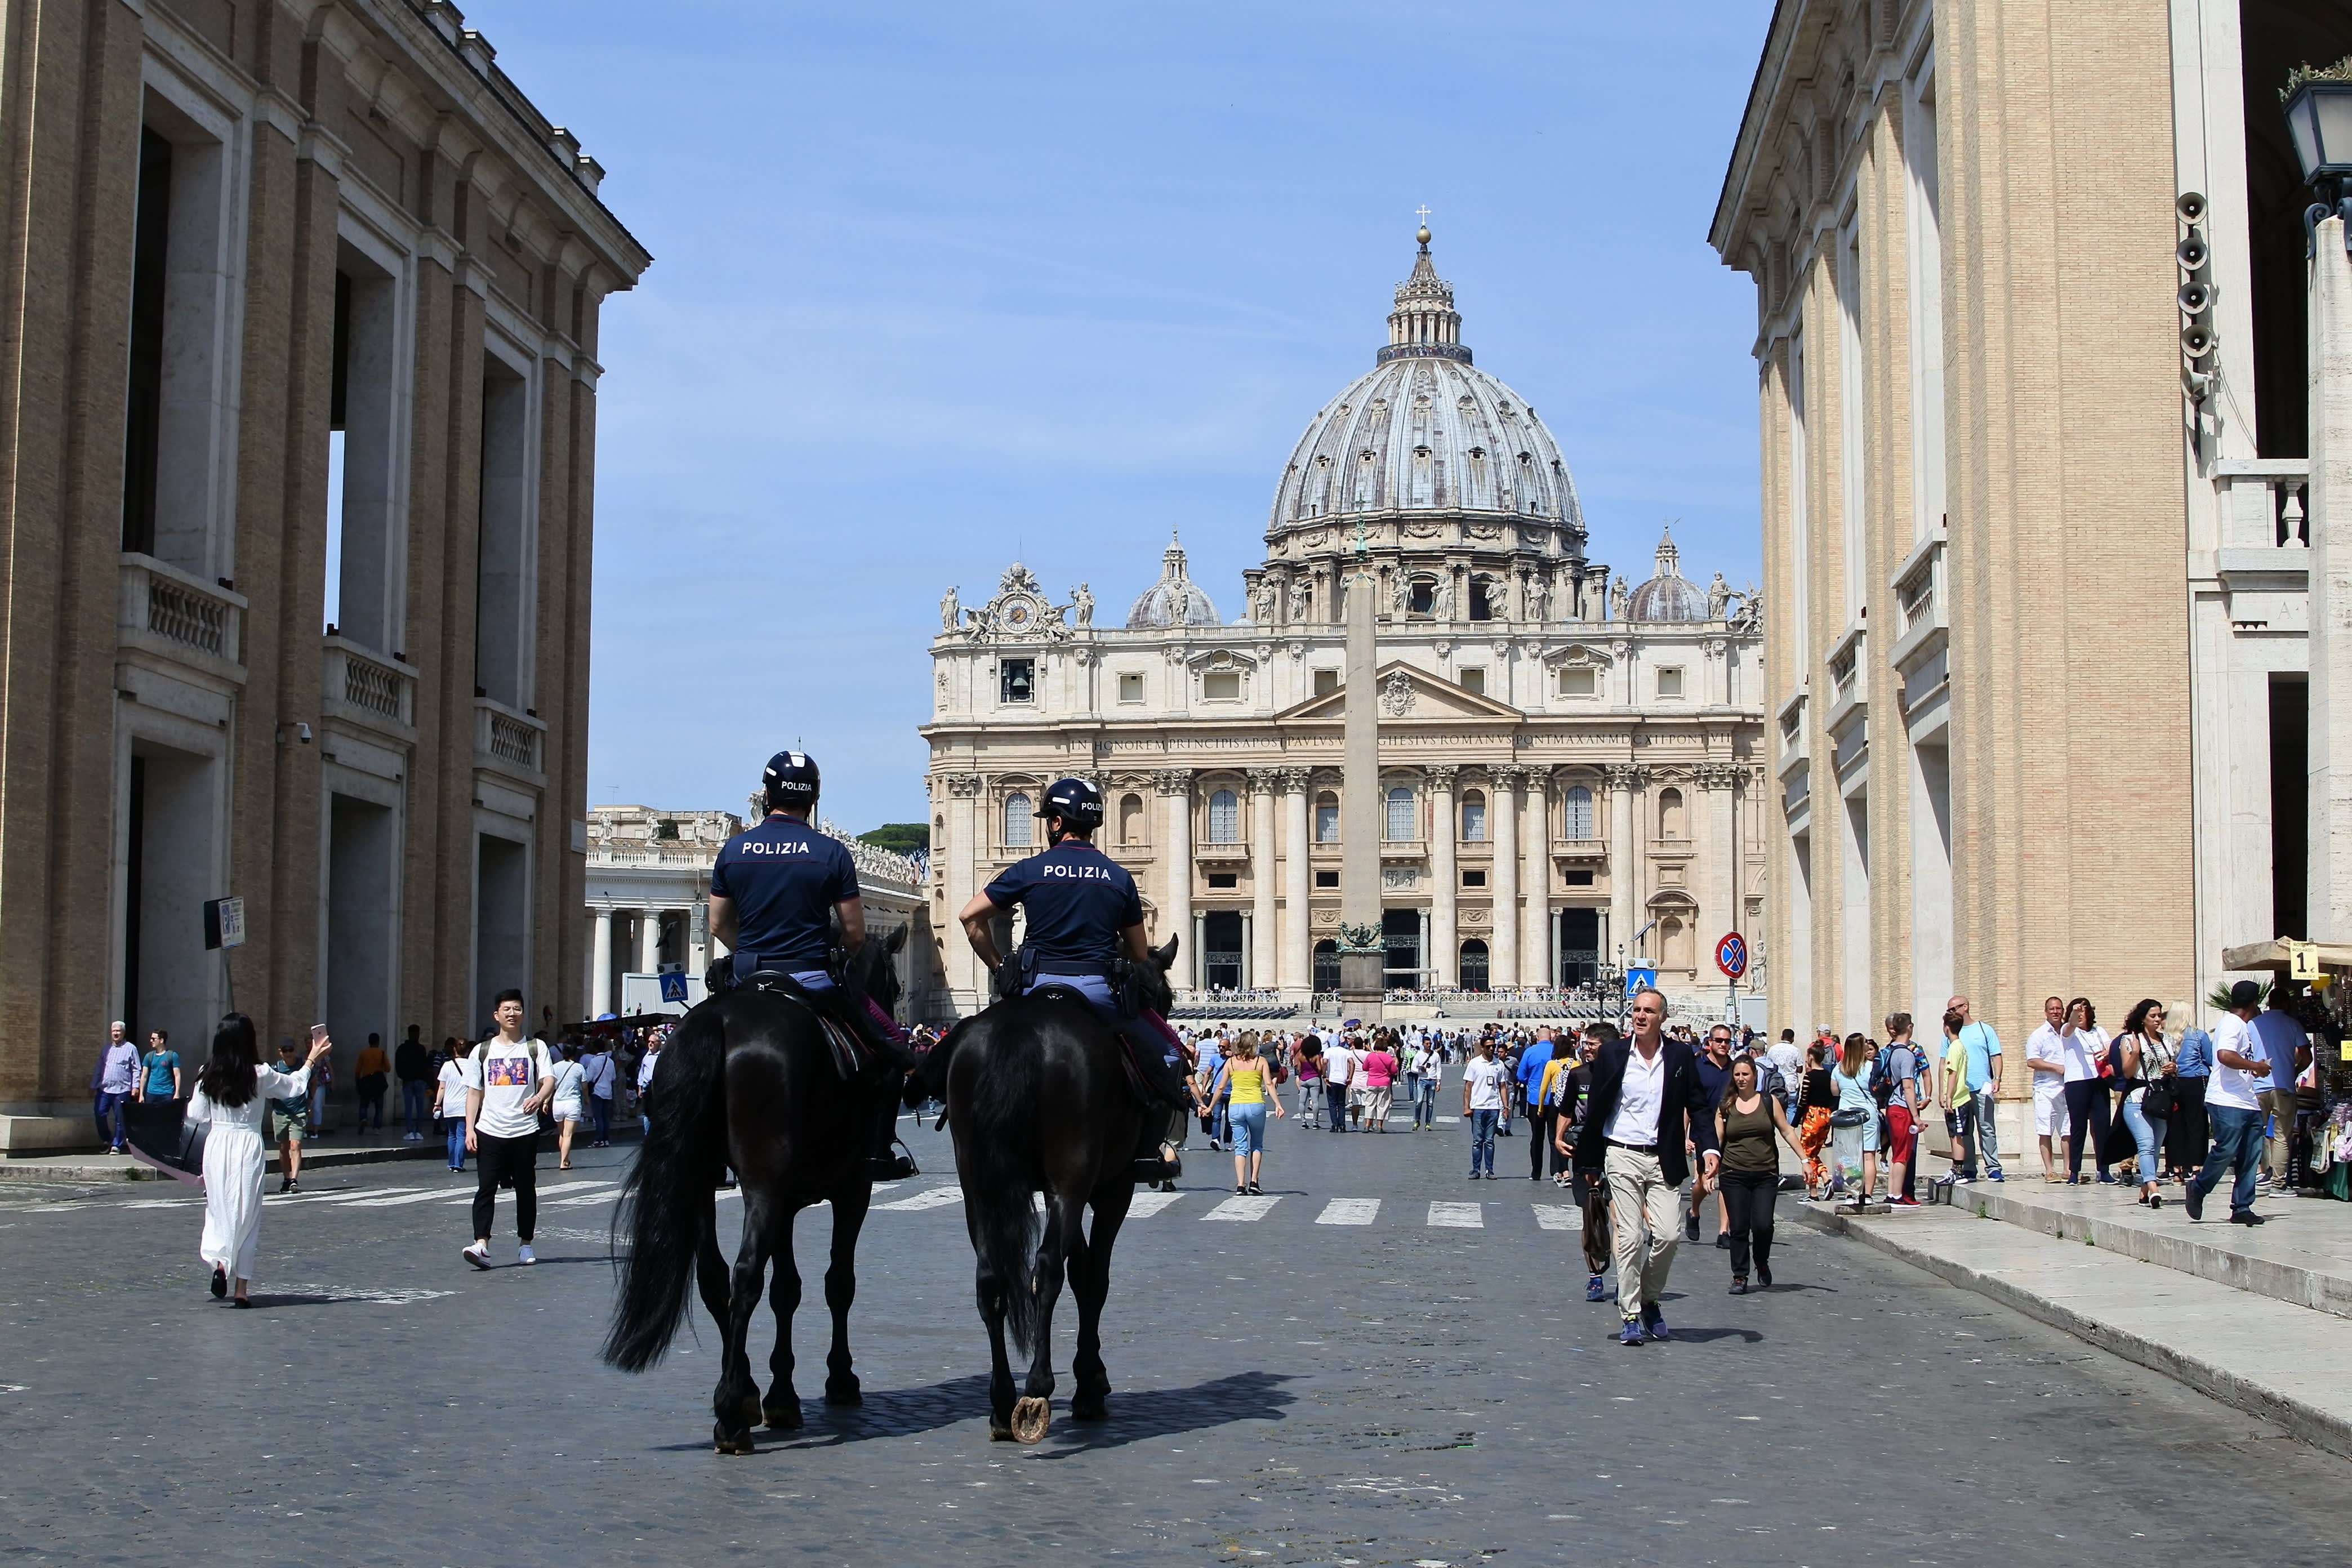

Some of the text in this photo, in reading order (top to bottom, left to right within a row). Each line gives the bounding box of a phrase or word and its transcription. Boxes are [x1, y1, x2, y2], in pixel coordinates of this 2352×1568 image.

[1072, 740, 1087, 750] IN
[1095, 740, 1165, 750] HONOREM
[1169, 737, 1239, 749] PRINCIPIS
[1288, 736, 1334, 746] PAVLVS
[1440, 734, 1512, 745] ROMANVS
[1710, 734, 1730, 743] VII
[782, 781, 812, 791] POLIZIA
[742, 841, 809, 854] POLIZIA
[1044, 865, 1111, 881] POLIZIA
[2297, 952, 2307, 973] 1
